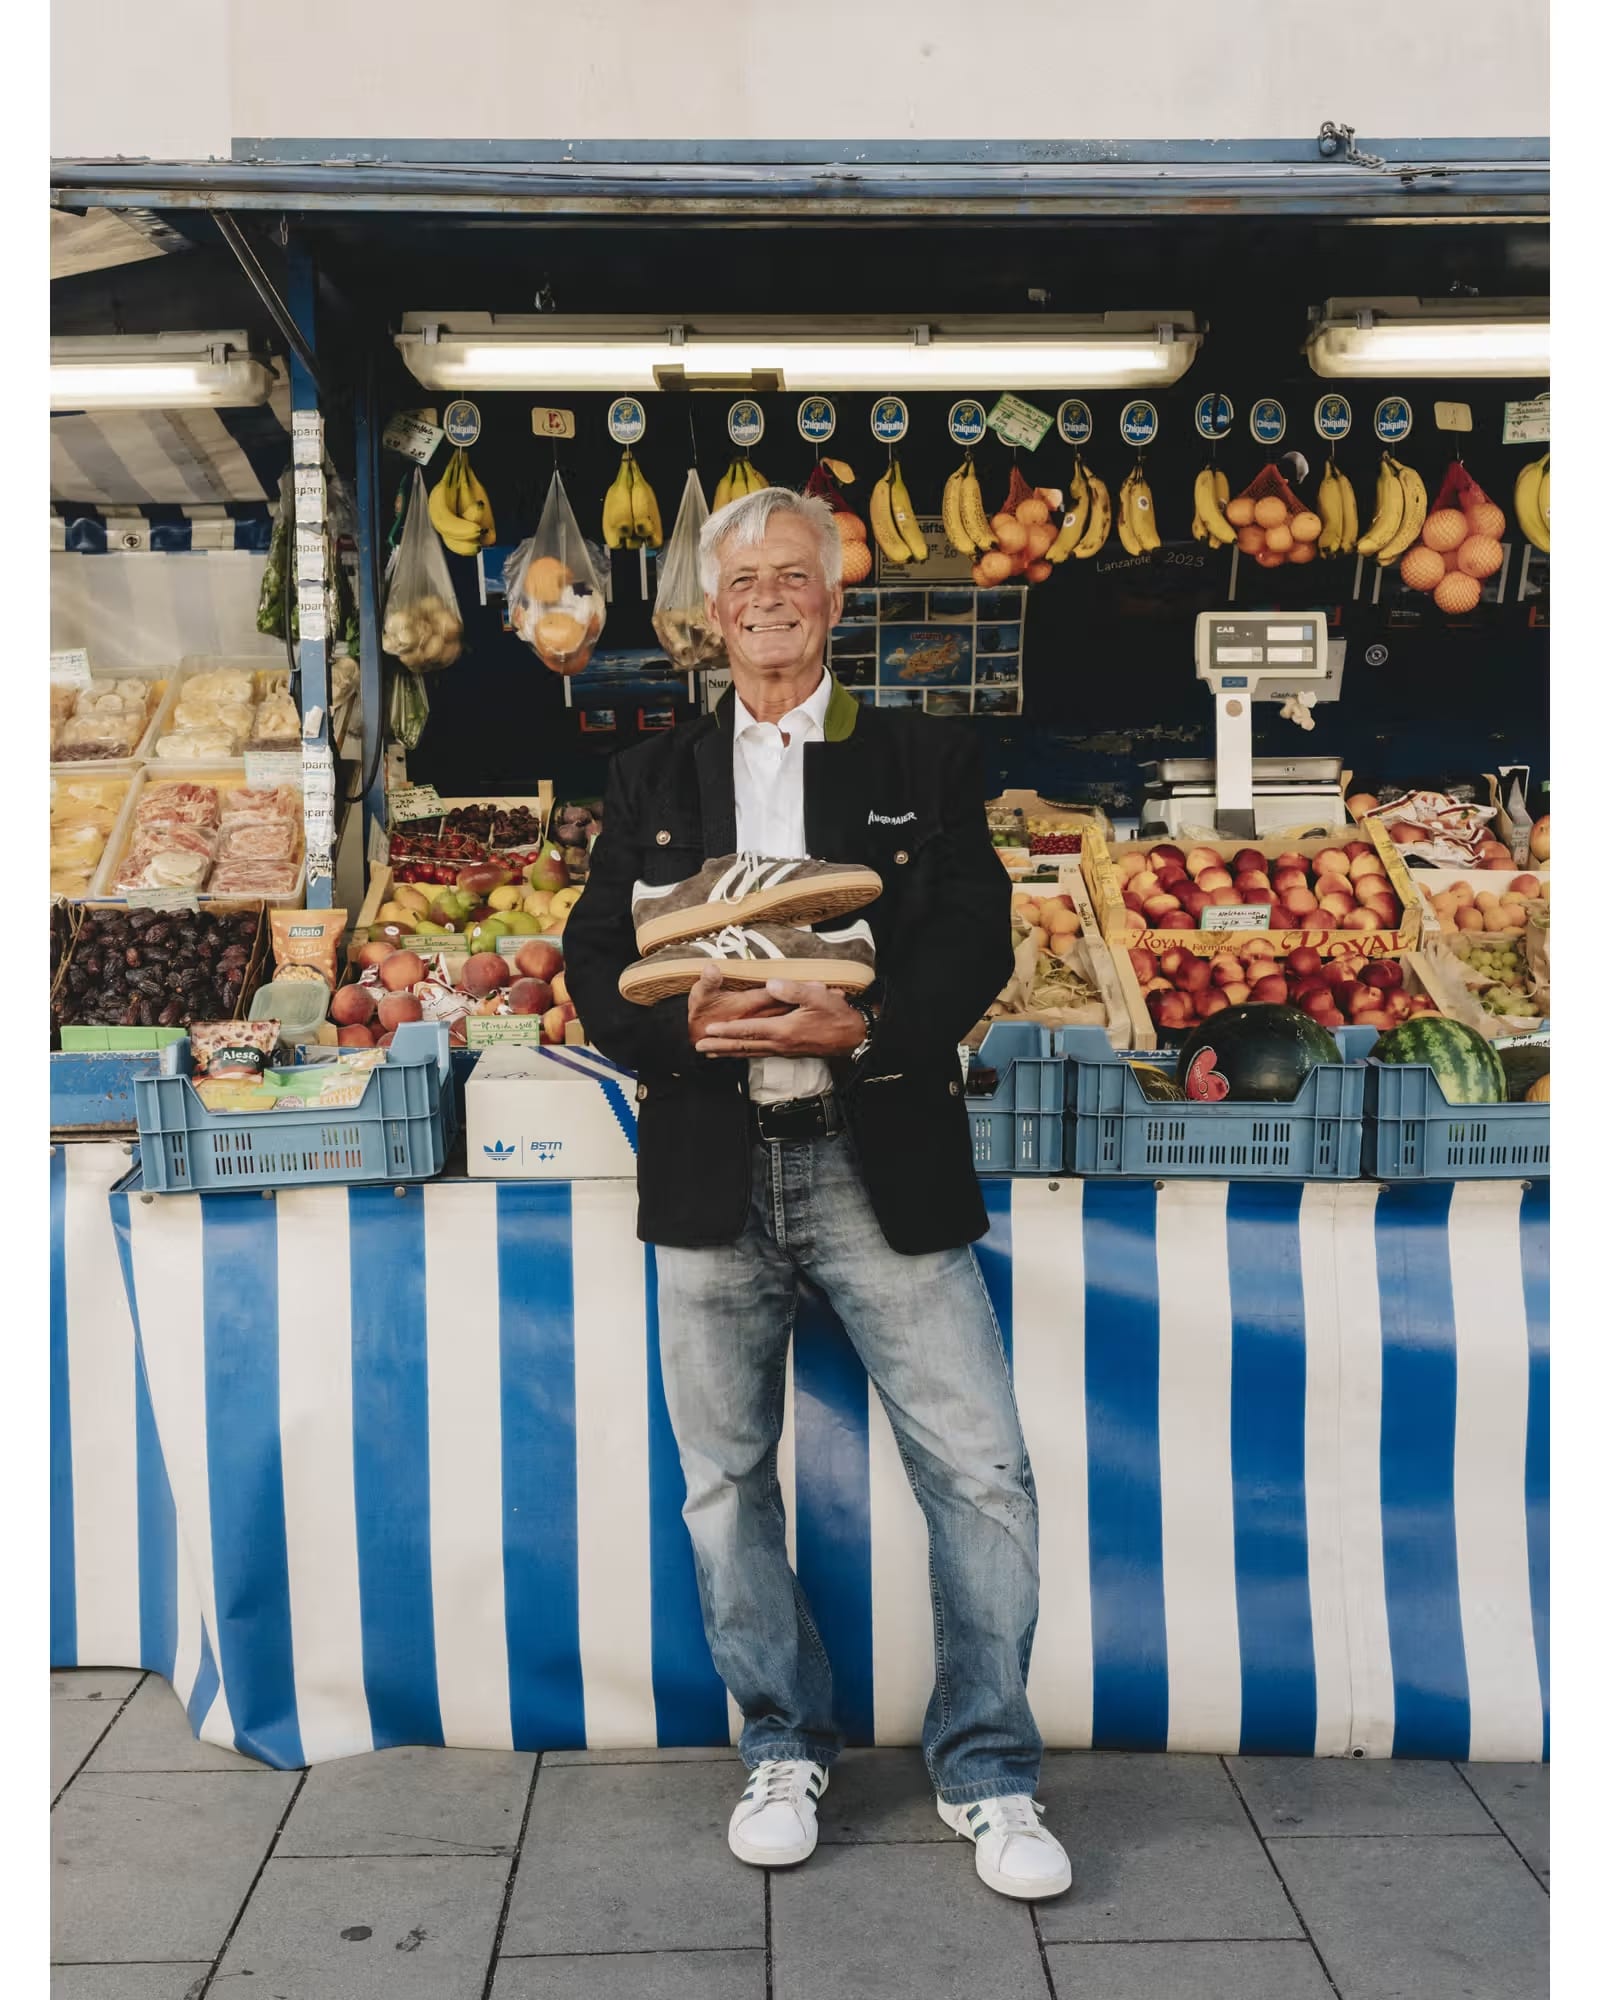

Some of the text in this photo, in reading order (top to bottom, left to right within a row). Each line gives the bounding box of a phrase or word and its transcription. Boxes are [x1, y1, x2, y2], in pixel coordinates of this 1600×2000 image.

[801, 418, 832, 432] Chiquita
[874, 420, 905, 433] Chiquita
[951, 422, 982, 436] Chiquita
[1062, 422, 1090, 434] Chiquita
[1123, 423, 1153, 436] Chiquita
[1256, 418, 1281, 430] Chiquita
[1320, 418, 1349, 431] Chiquita
[1378, 419, 1408, 434] Chiquita
[291, 927, 321, 937] Alesto
[222, 1050, 260, 1063] Alesto
